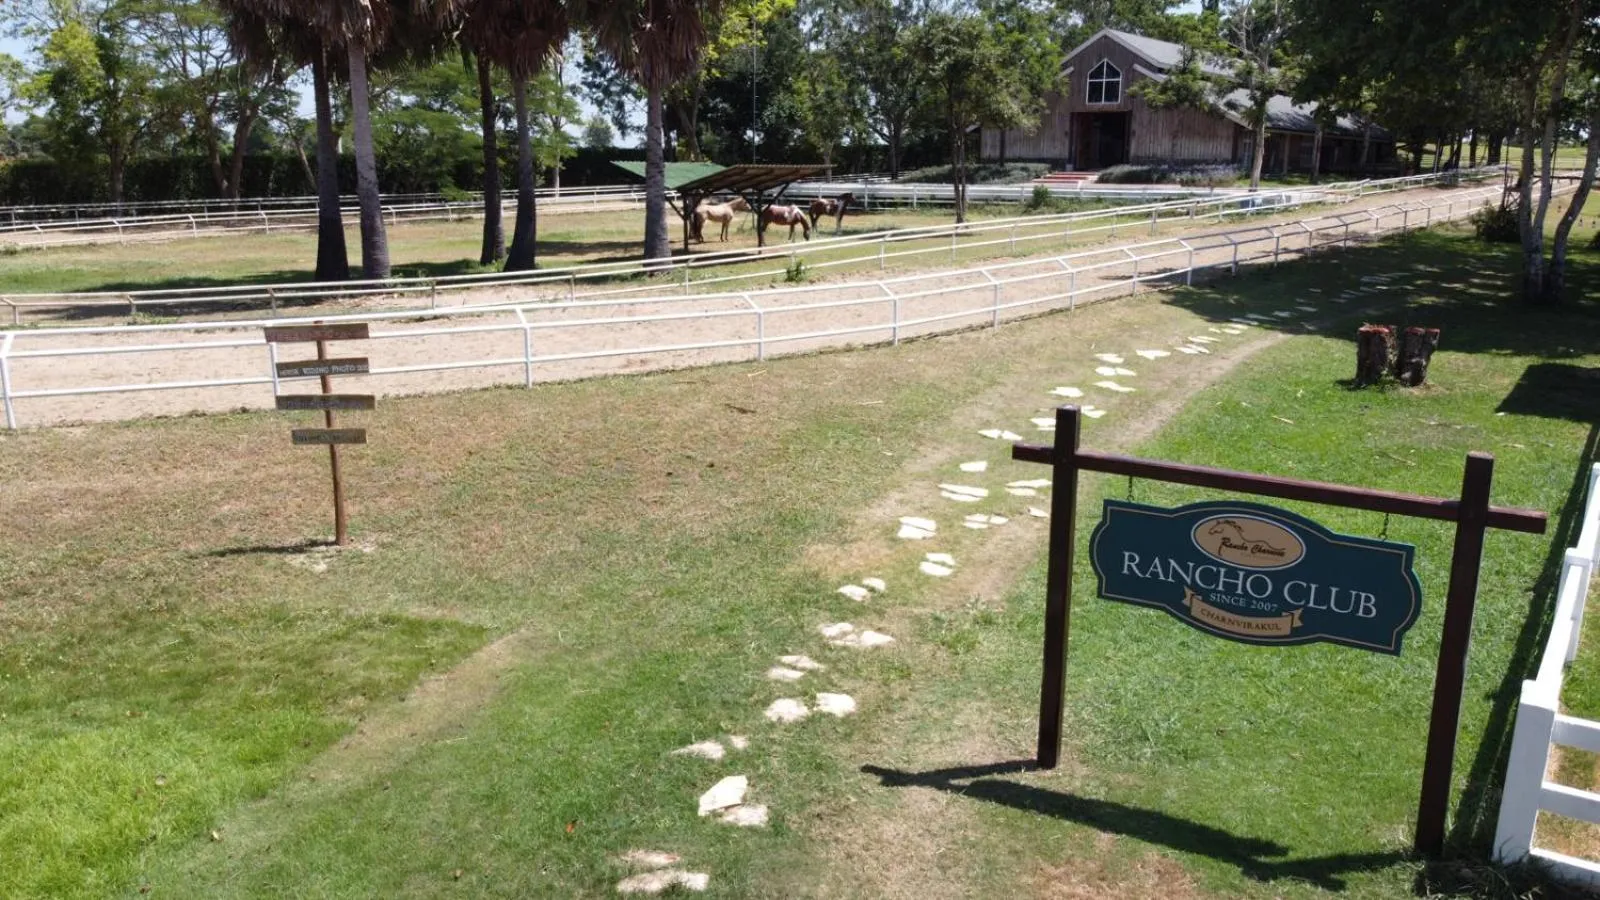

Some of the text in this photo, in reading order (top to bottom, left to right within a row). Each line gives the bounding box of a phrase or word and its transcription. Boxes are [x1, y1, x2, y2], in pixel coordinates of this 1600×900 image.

[1121, 551, 1378, 618] RANCHO CLUB
[1210, 593, 1279, 612] SINCE 2007
[1200, 608, 1282, 632] CHARNVIRAKUL
